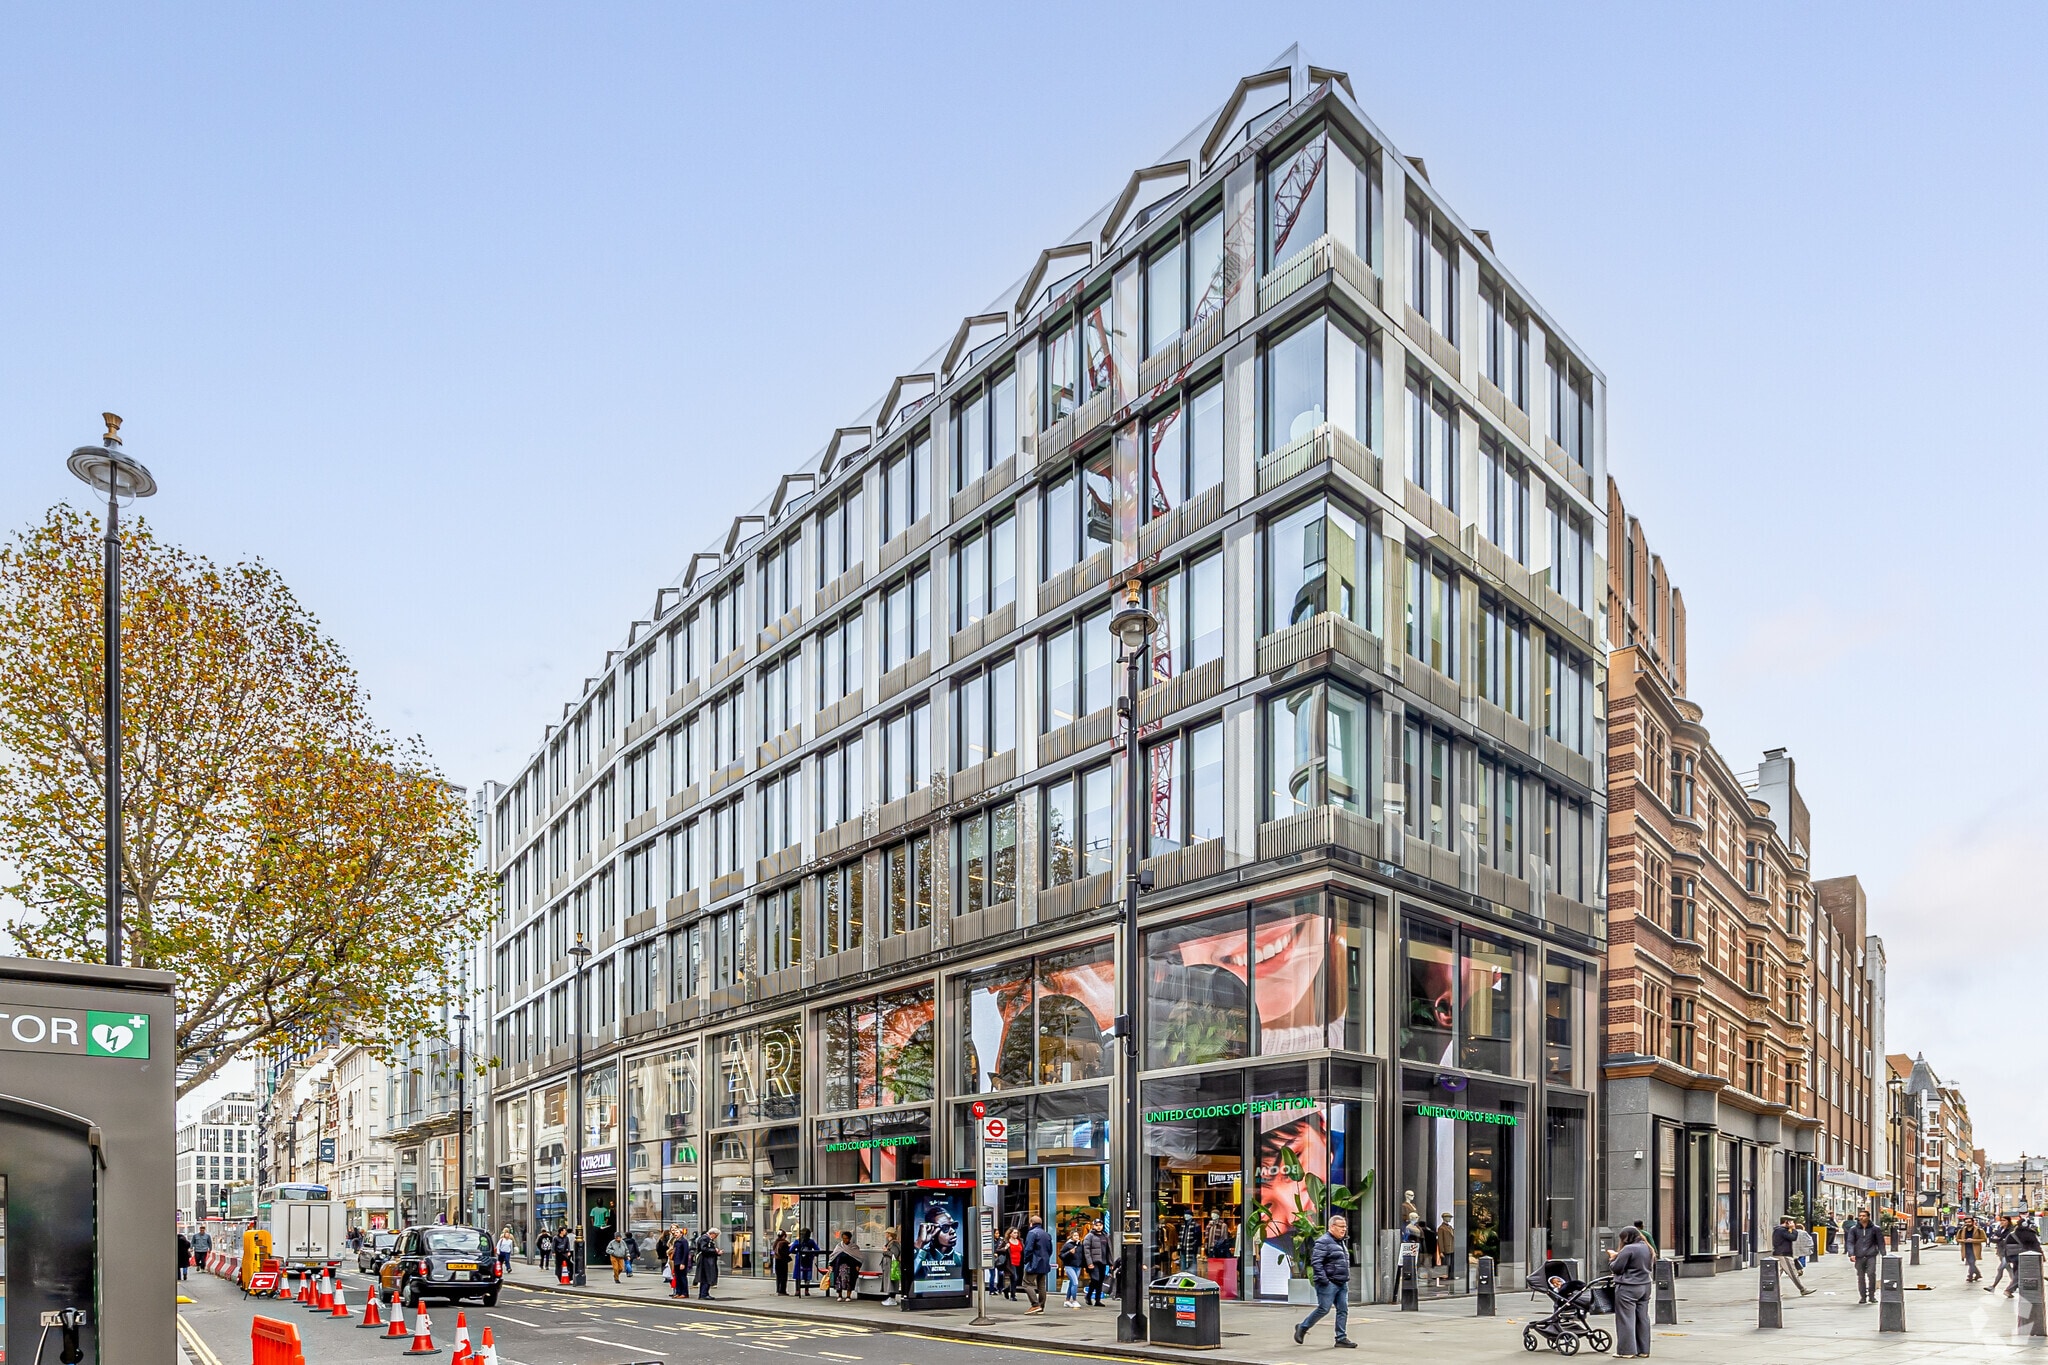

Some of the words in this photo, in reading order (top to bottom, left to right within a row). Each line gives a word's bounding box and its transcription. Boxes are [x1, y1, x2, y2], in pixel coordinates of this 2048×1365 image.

[975, 1105, 984, 1113] YB
[1145, 1109, 1184, 1123] UNITED
[1186, 1104, 1230, 1120] COLORS
[1232, 1102, 1248, 1115] OF
[1417, 1105, 1445, 1118] UNITED
[1445, 1108, 1474, 1121] COLORS
[1474, 1111, 1484, 1122] OF
[825, 1142, 848, 1152] UNITED
[848, 1140, 872, 1150] COLORS
[872, 1139, 882, 1148] OF
